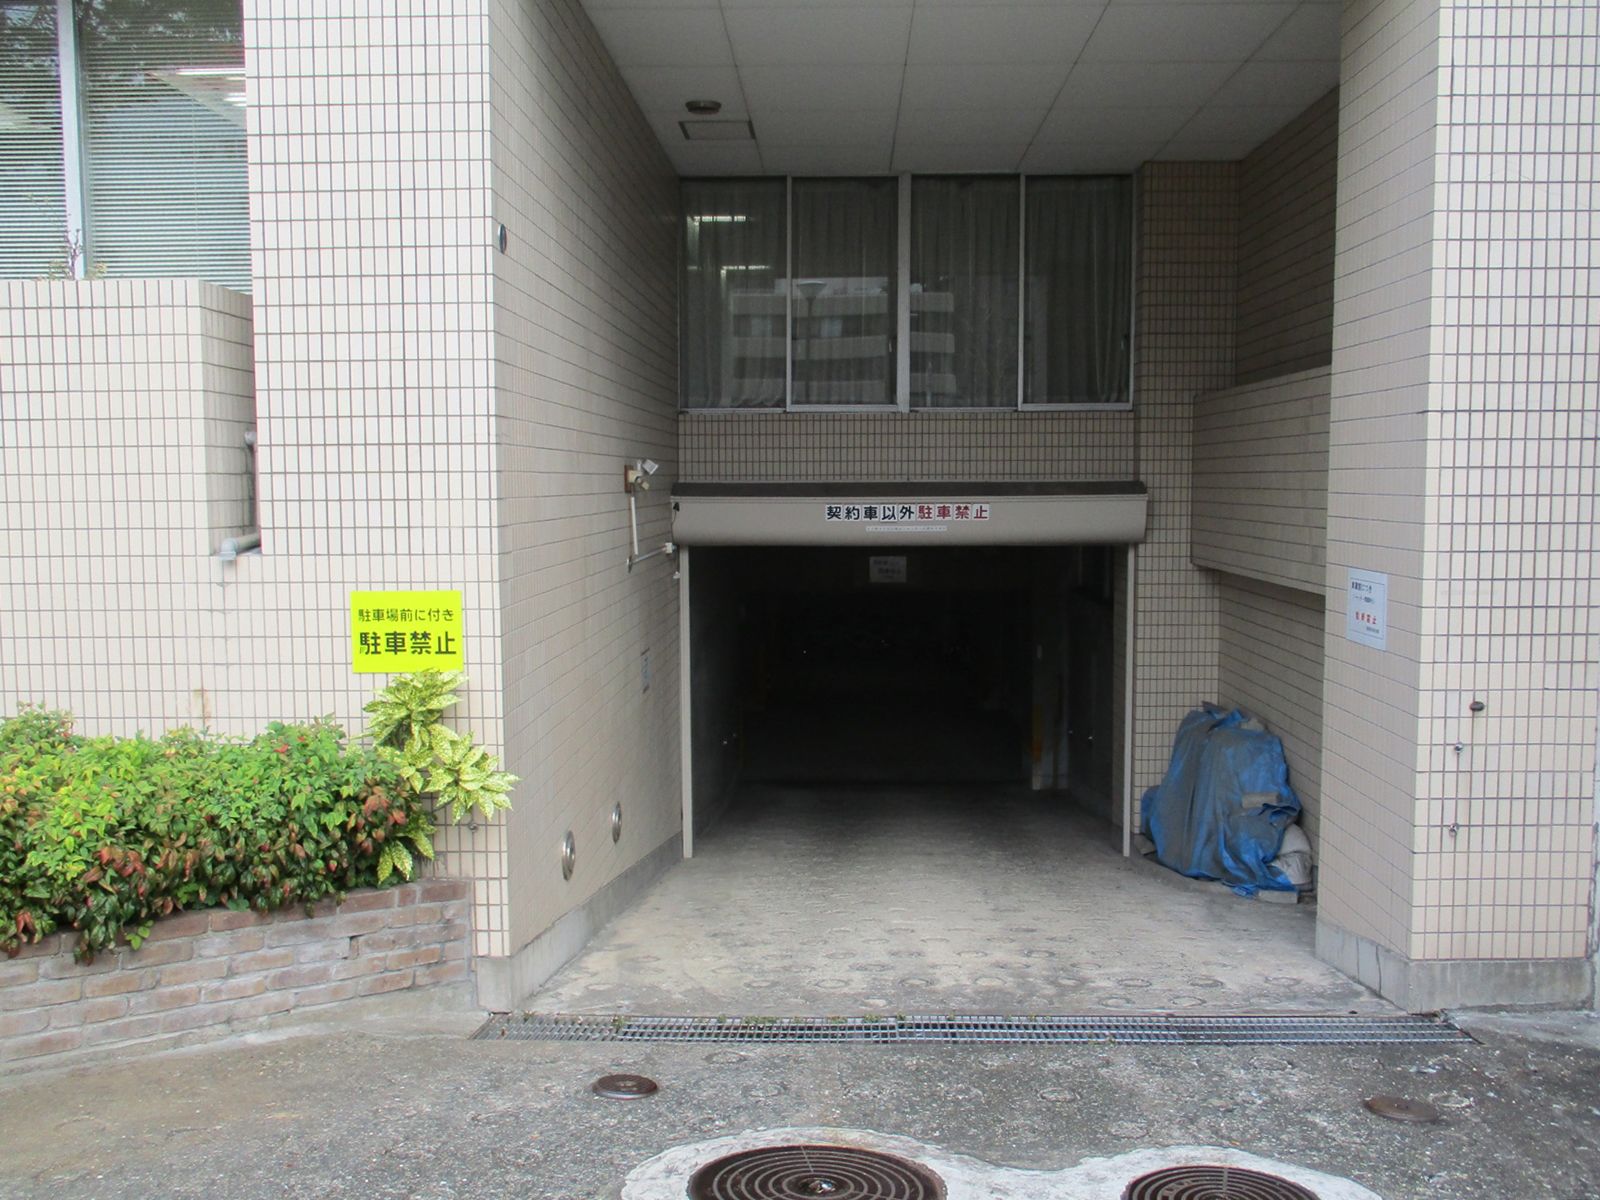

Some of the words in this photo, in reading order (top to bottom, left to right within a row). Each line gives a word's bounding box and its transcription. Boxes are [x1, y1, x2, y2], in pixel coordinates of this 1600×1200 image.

[827, 505, 988, 520] 契約車以外駐車禁止
[358, 608, 454, 622] 駐車場前に付き
[359, 631, 456, 655] 駐車禁止
